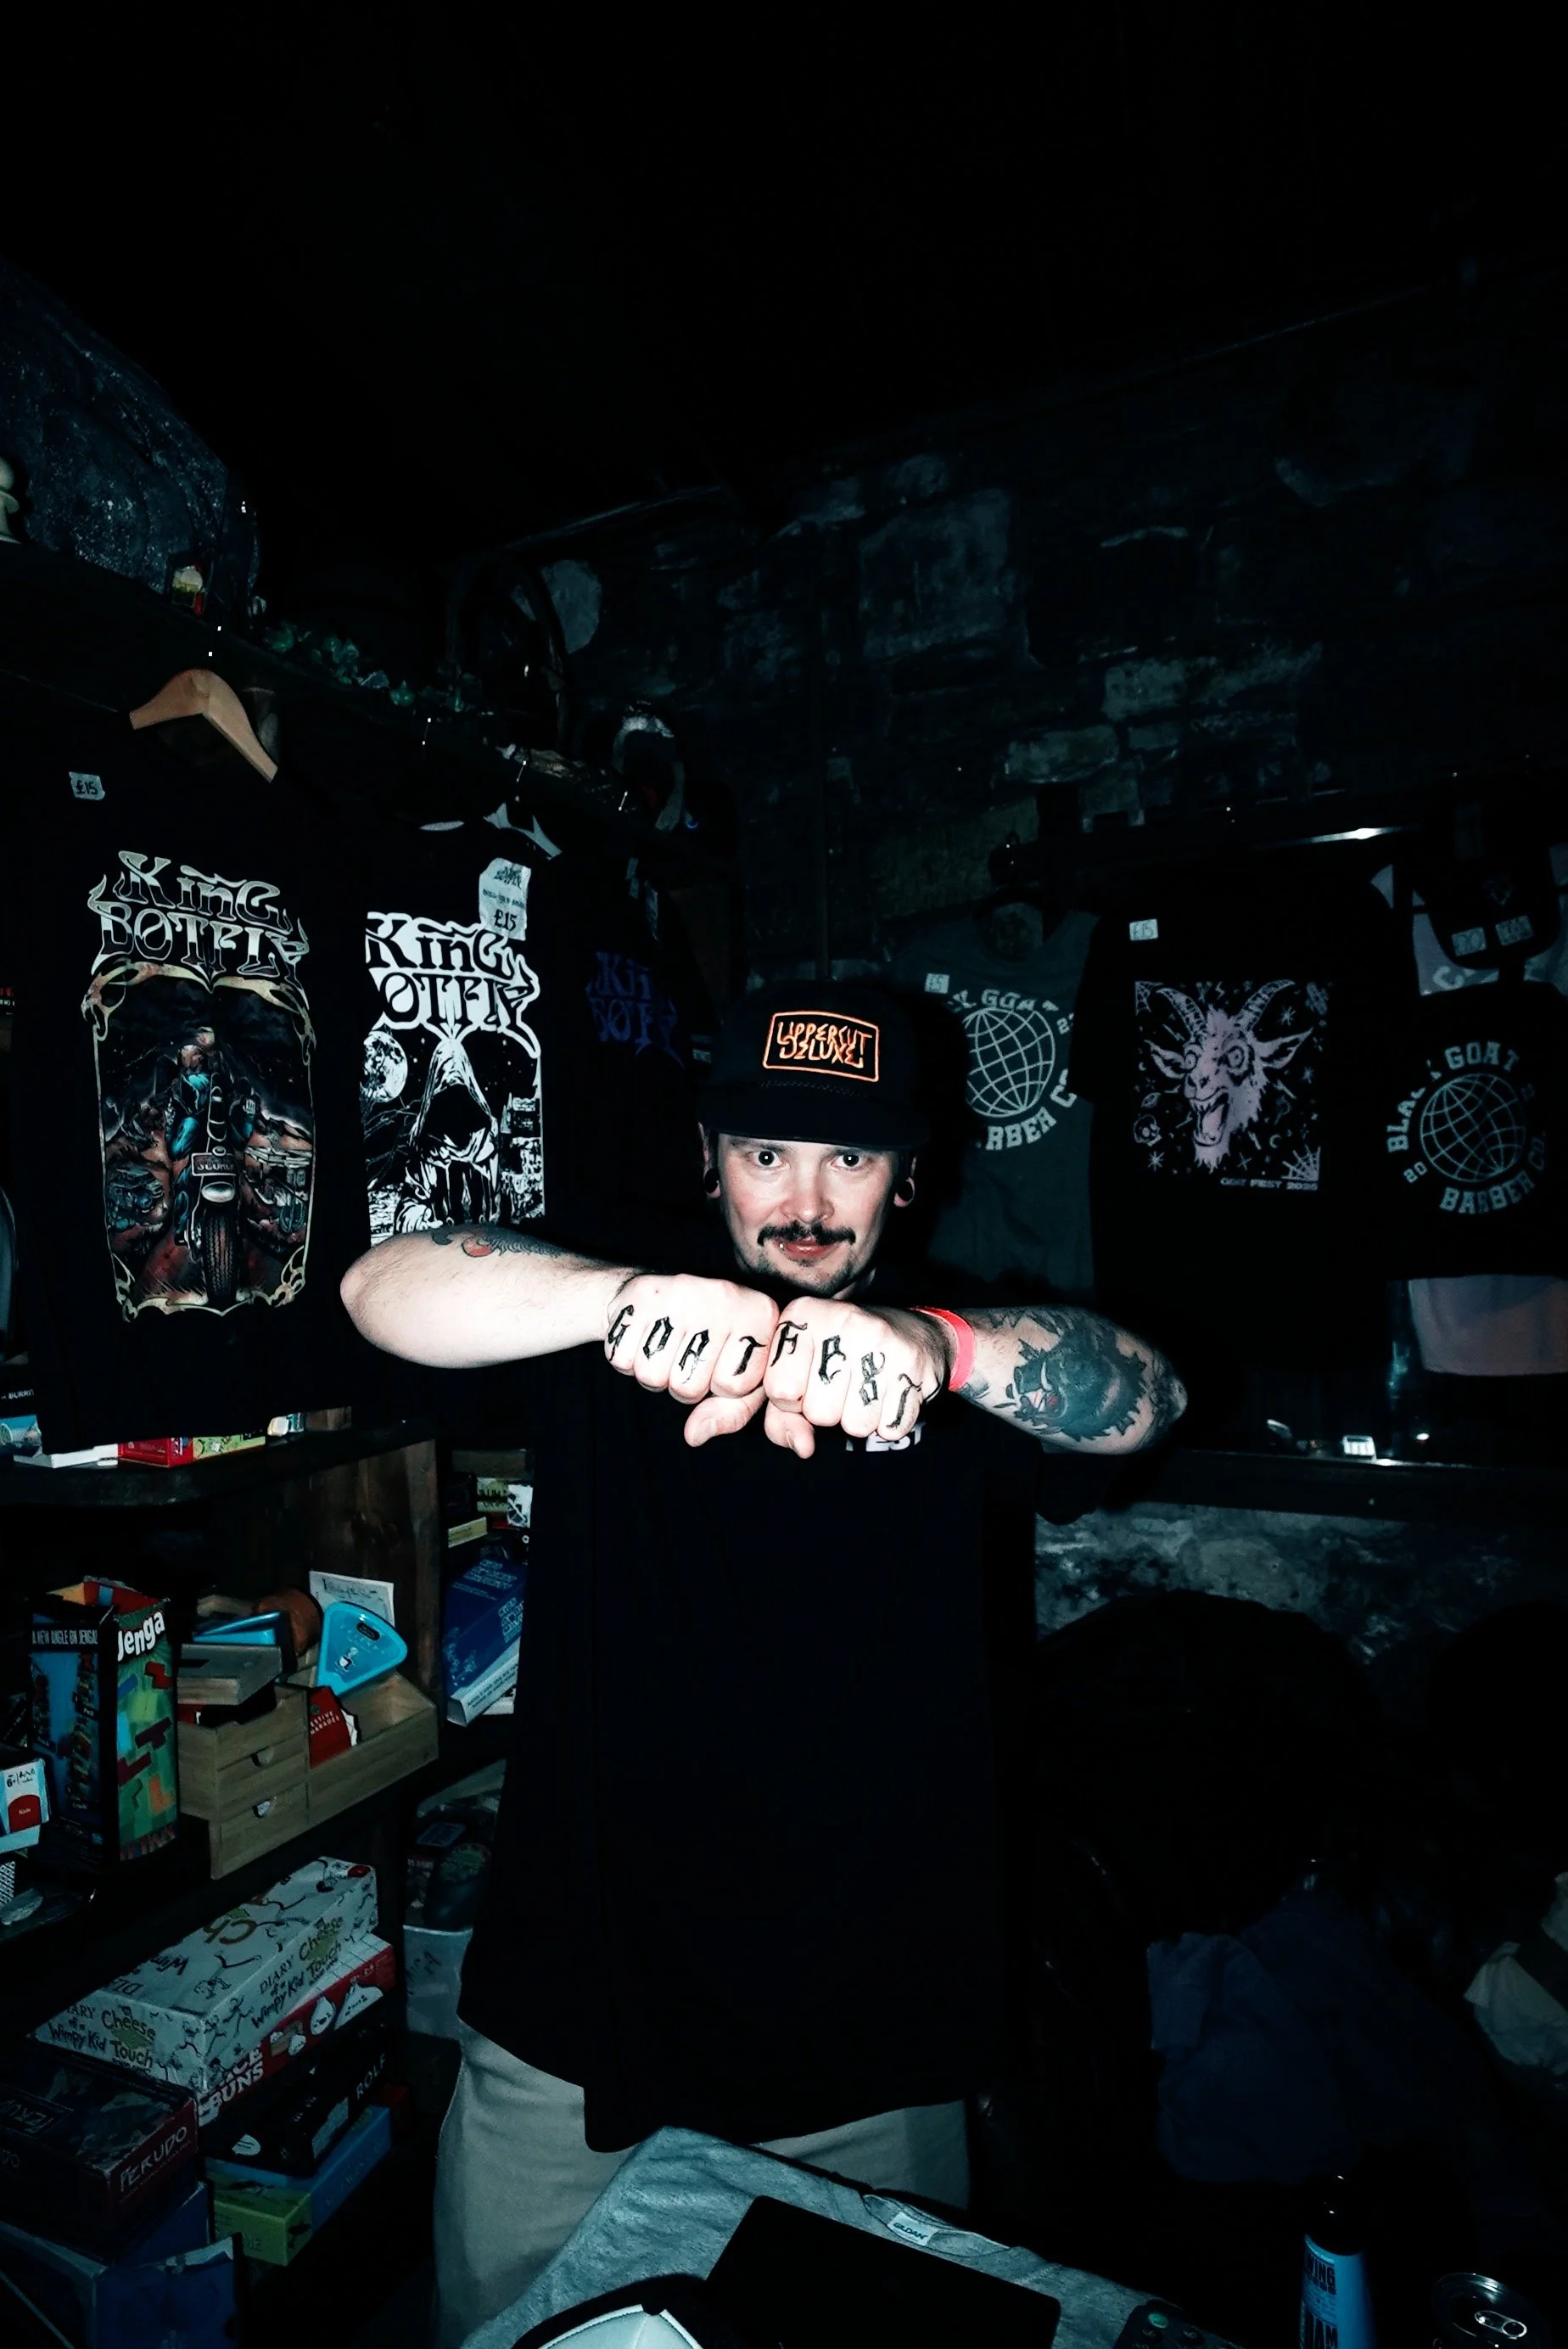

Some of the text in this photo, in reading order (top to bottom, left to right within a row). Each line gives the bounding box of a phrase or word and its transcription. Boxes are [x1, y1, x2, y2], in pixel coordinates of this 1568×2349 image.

[76, 779, 98, 795] £15
[495, 909, 518, 932] £15
[776, 1021, 873, 1055] UPPERCUT
[1439, 1169, 1537, 1215] BARBER
[117, 1611, 165, 1662] Jenga
[260, 1955, 293, 1994] DIARY
[48, 2021, 107, 2052] Wimpy Kid
[101, 2010, 156, 2044] Cheese
[110, 2039, 154, 2070] Touch
[210, 2060, 265, 2111] BUNS
[120, 2125, 188, 2193] PERUDO
